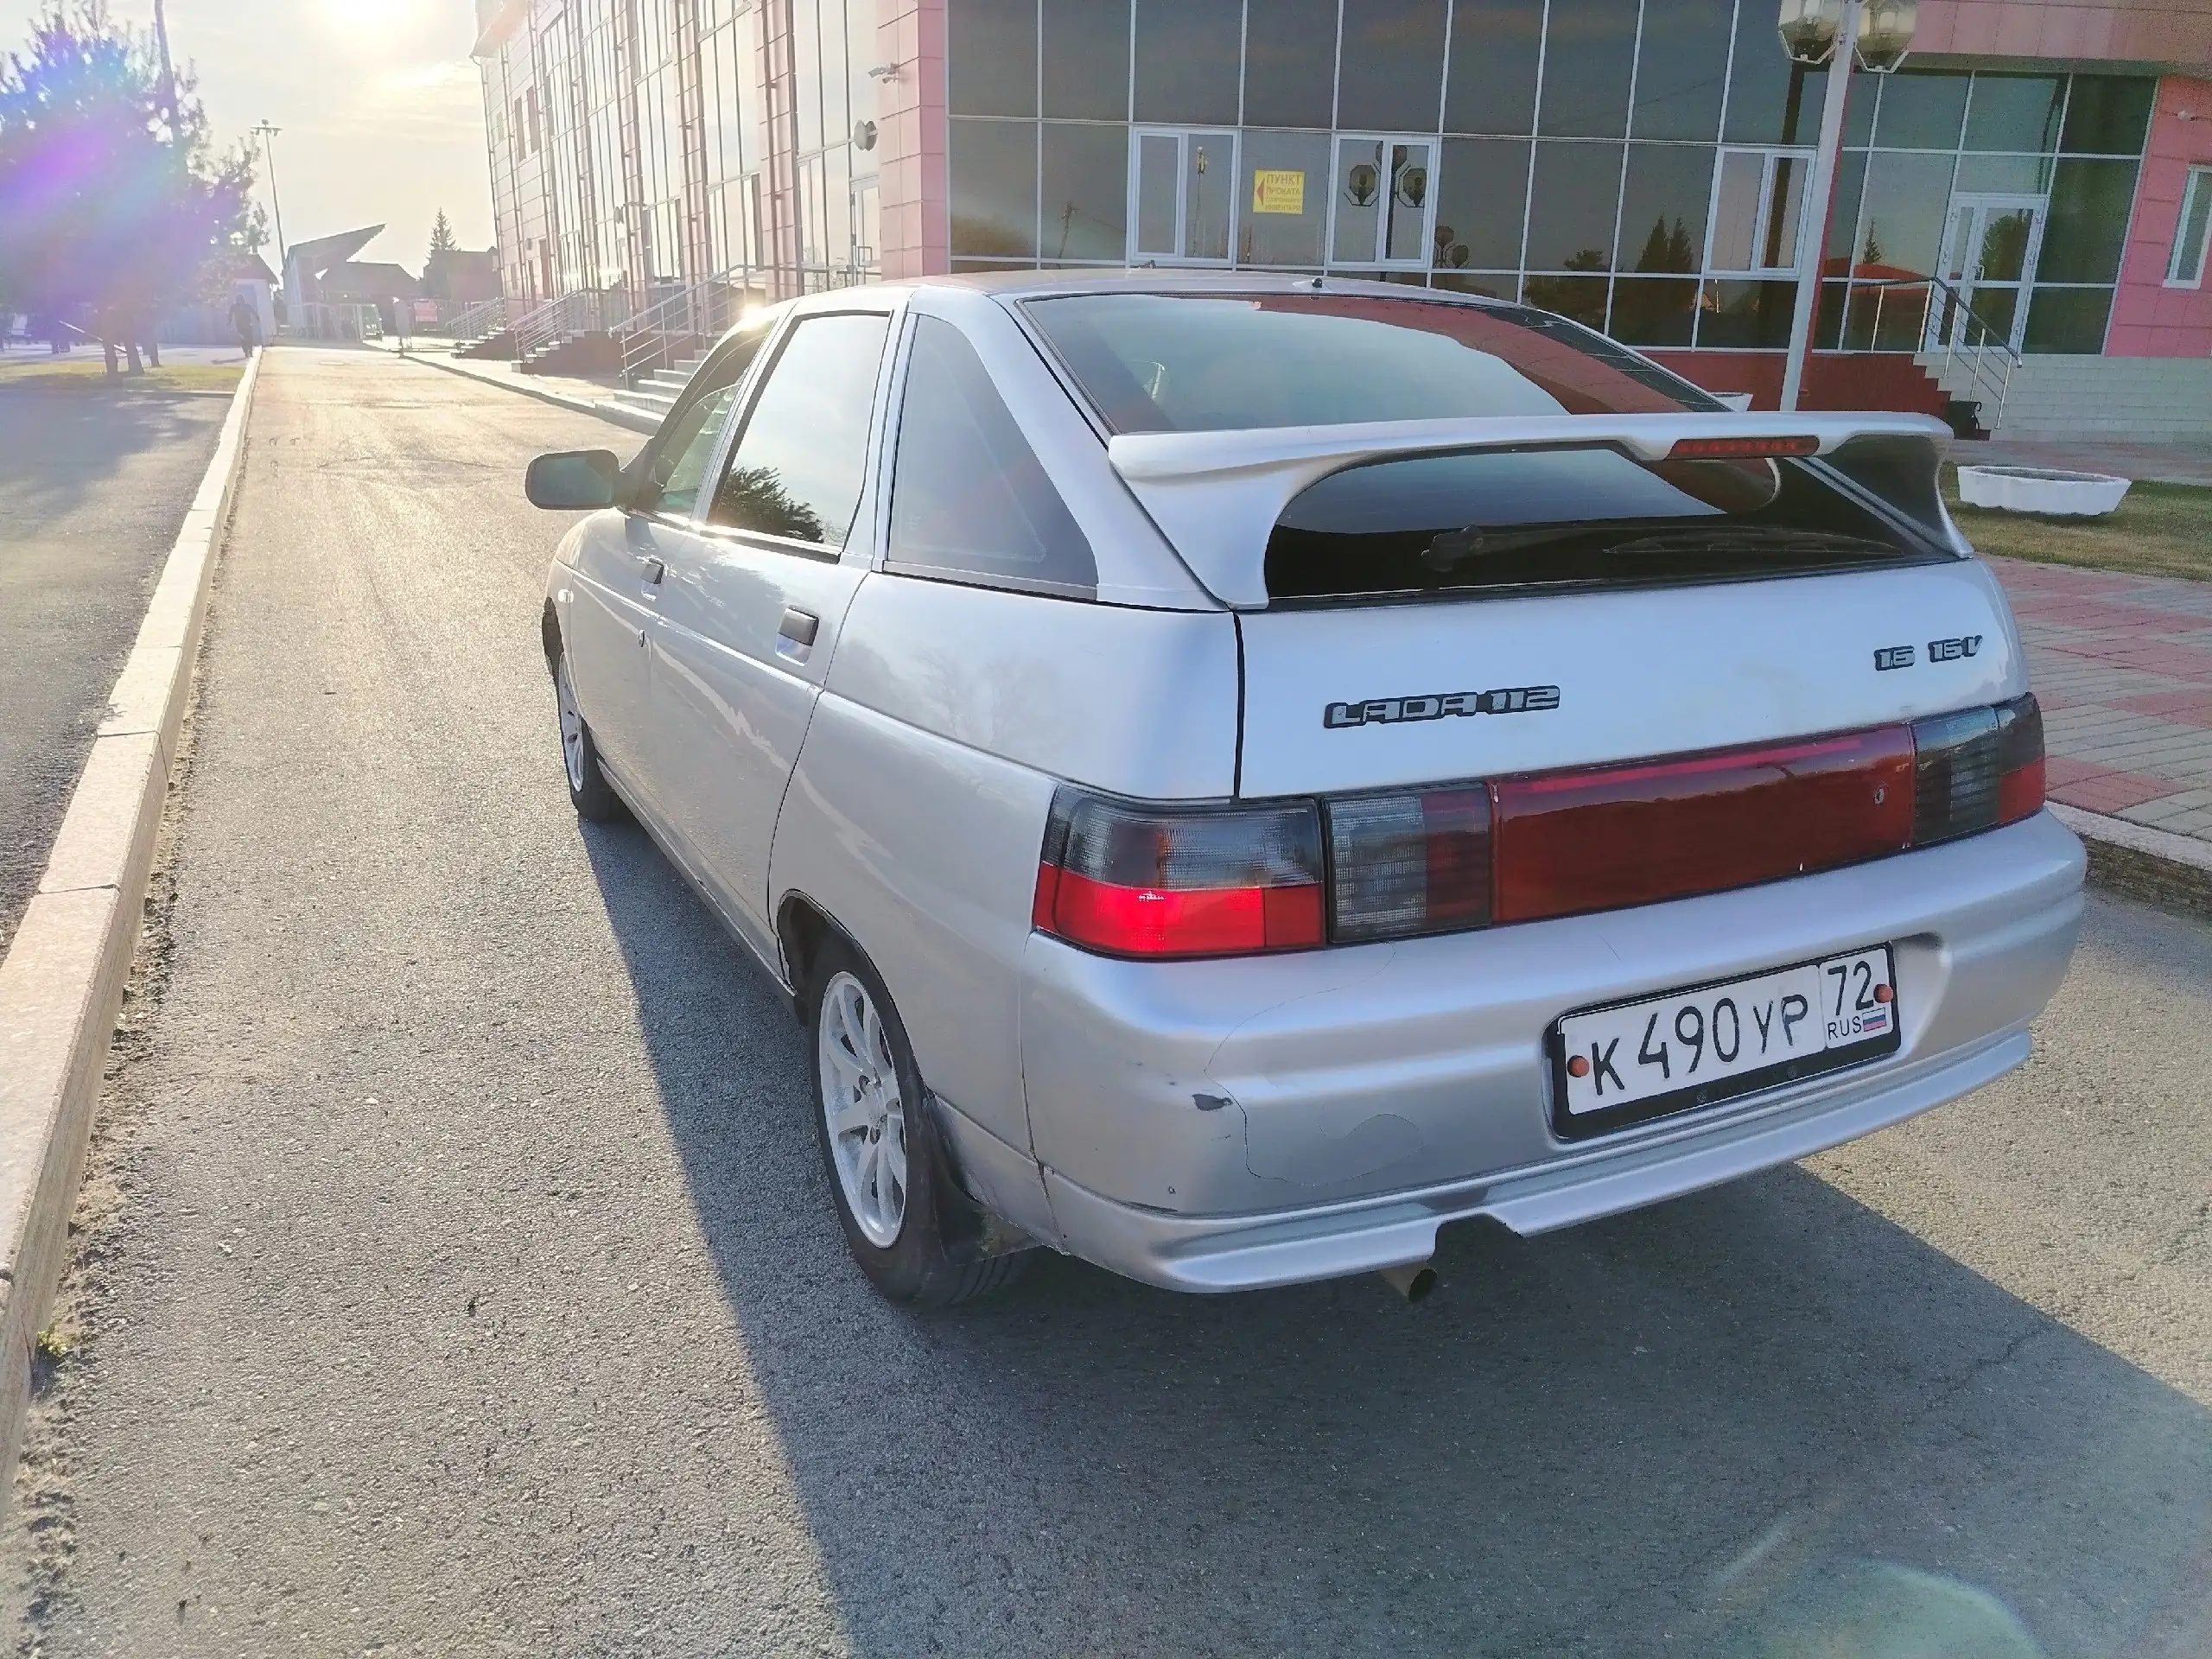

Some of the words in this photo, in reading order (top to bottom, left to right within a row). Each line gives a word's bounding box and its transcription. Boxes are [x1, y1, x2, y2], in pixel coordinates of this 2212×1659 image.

[1266, 174, 1301, 185] ПУНКТ
[1928, 635, 1983, 663] 16V
[1324, 691, 1478, 728] LADA
[1484, 685, 1560, 715] 112
[1827, 960, 1874, 1016] 72
[1827, 1015, 1862, 1040] RUS
